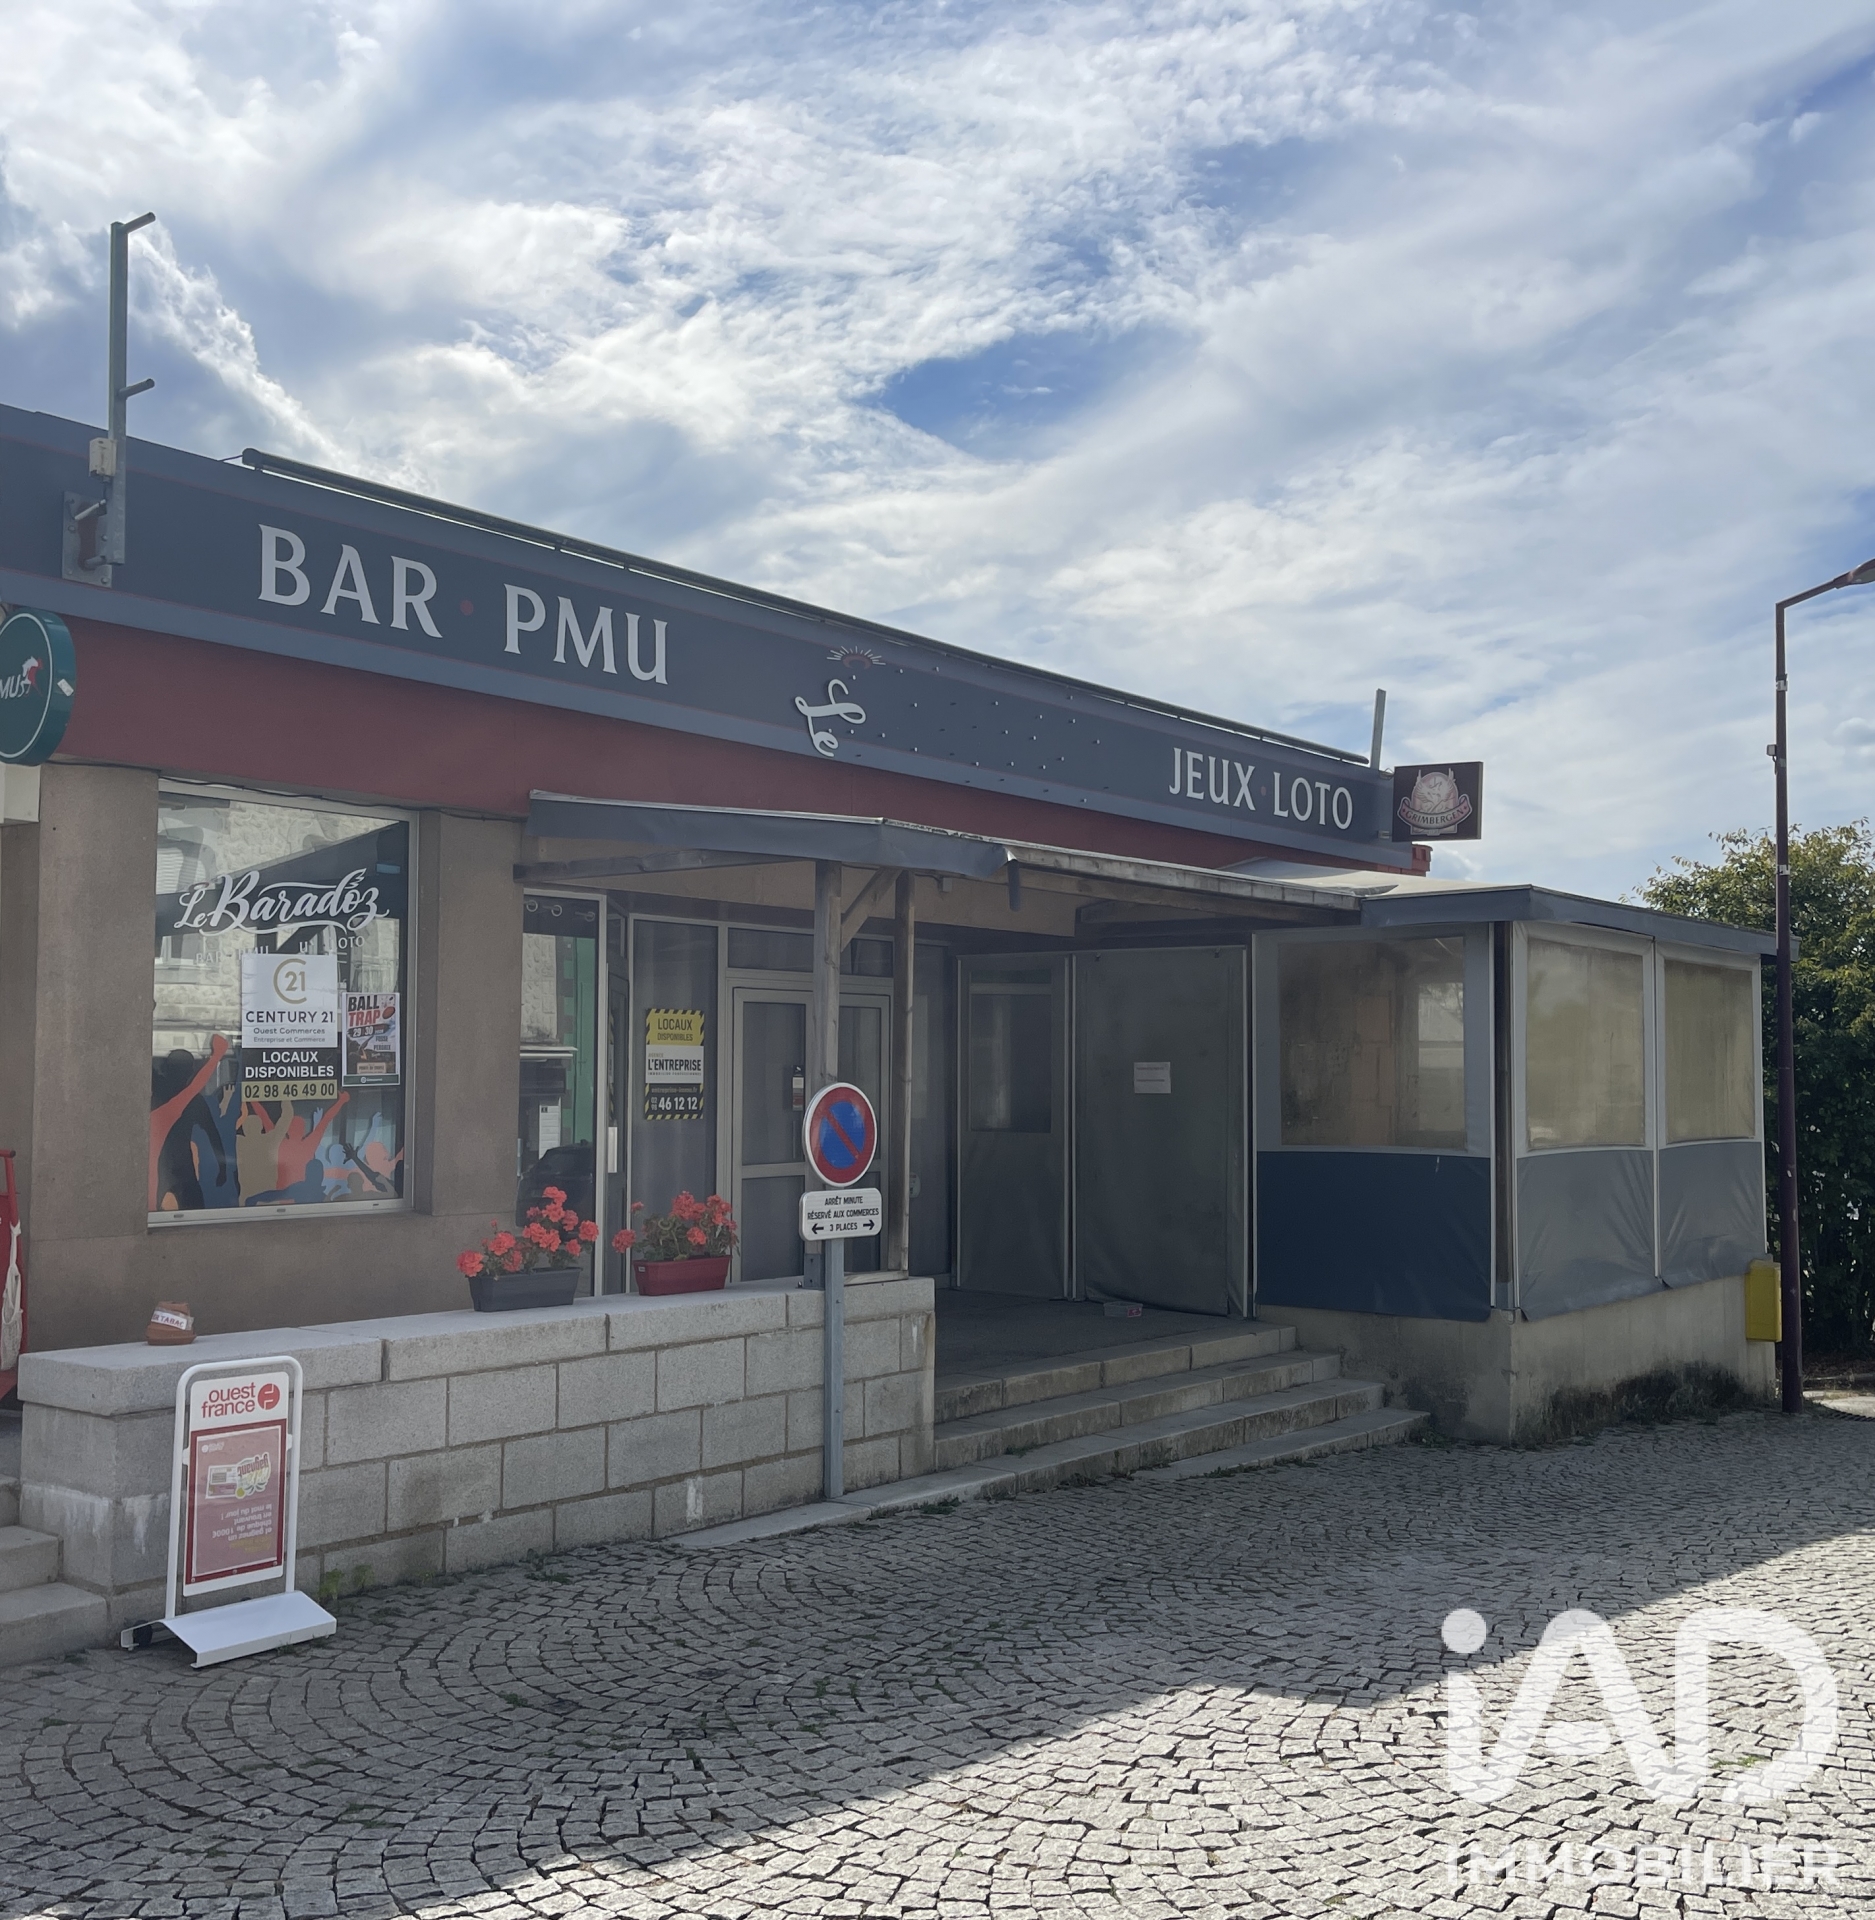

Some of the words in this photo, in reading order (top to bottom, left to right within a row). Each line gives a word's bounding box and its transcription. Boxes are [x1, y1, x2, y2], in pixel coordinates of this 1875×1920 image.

[258, 524, 442, 638] BAR
[503, 583, 668, 685] PMU
[0, 674, 21, 699] MU
[795, 679, 867, 757] Le
[1169, 746, 1256, 811] JEUX
[1273, 771, 1353, 830] LOTO
[1406, 807, 1464, 825] GRIMBERGEN
[174, 888, 207, 929] Le
[338, 936, 365, 948] OTO
[348, 995, 380, 1011] BALL
[246, 1011, 317, 1023] CENTURY
[321, 1011, 334, 1023] 21
[348, 1010, 381, 1027] TRAP
[658, 1018, 692, 1031] LOCAUX
[280, 1027, 325, 1035] Commerces
[364, 1026, 374, 1036] 30
[657, 1033, 693, 1041] DISPONIBLES
[262, 1051, 318, 1063] LOCAUX
[648, 1059, 701, 1071] L'ENTREPRISE
[245, 1065, 334, 1078] DISPONIBLES
[245, 1085, 260, 1098] 02
[264, 1084, 279, 1098] 98
[283, 1084, 298, 1097] 46
[302, 1083, 316, 1097] 49
[321, 1083, 335, 1096] 00
[658, 1097, 672, 1111] 46
[674, 1097, 685, 1111] 12
[687, 1096, 698, 1110] 12
[824, 1196, 842, 1206] ARRÊT
[843, 1196, 863, 1205] MINUTE
[807, 1209, 831, 1220] RÉSERVÉ
[833, 1210, 844, 1218] AUX
[846, 1208, 879, 1217] COMMERCES
[829, 1223, 834, 1232] 3
[836, 1222, 858, 1231] PLACES
[161, 1315, 185, 1328] TABAC
[209, 1382, 256, 1403] ouest
[201, 1400, 255, 1418] france
[225, 1509, 239, 1518] jour
[251, 1505, 264, 1513] mot
[263, 1511, 272, 1519] en
[233, 1514, 262, 1525] trouvant
[237, 1524, 246, 1532] de
